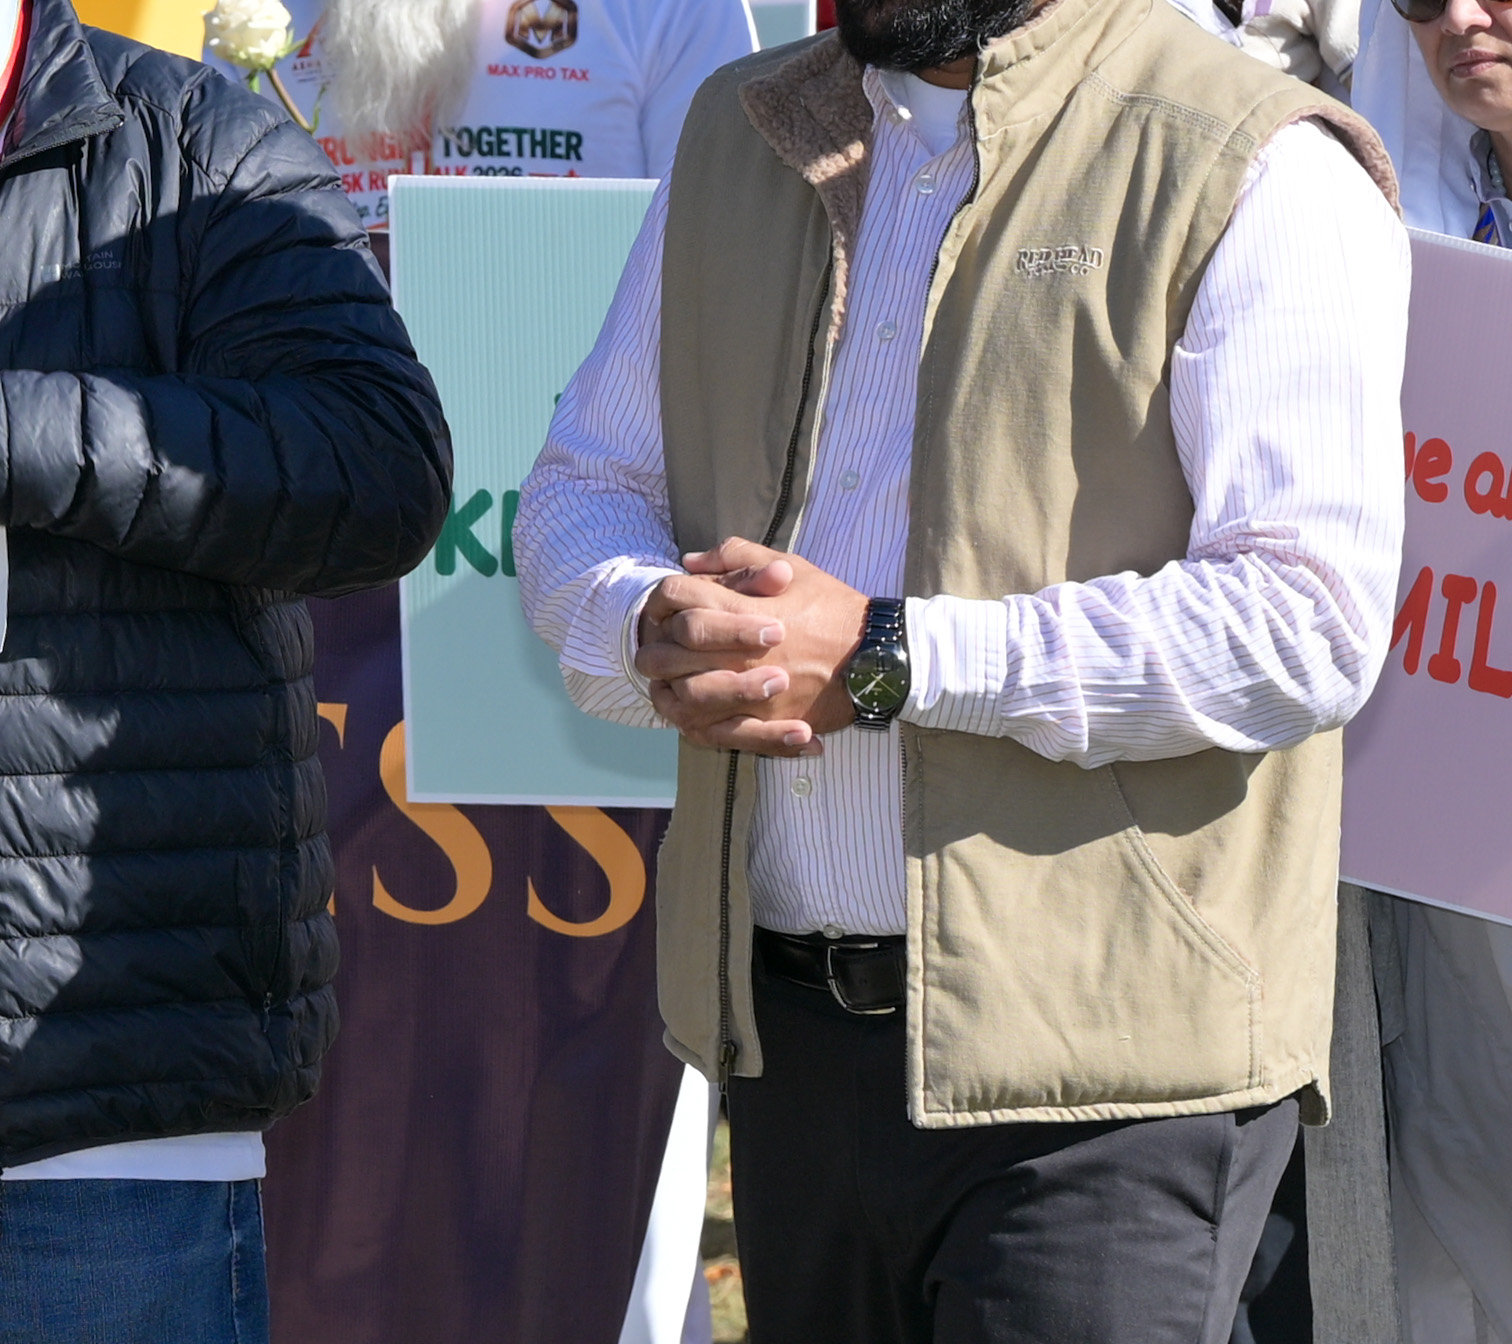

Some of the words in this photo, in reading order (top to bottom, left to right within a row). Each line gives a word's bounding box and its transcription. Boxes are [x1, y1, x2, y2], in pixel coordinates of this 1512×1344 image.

[487, 64, 520, 76] MAX
[524, 66, 556, 79] PRO
[561, 68, 590, 81] TAX
[439, 126, 584, 161] TOGETHER
[1403, 430, 1453, 503] e
